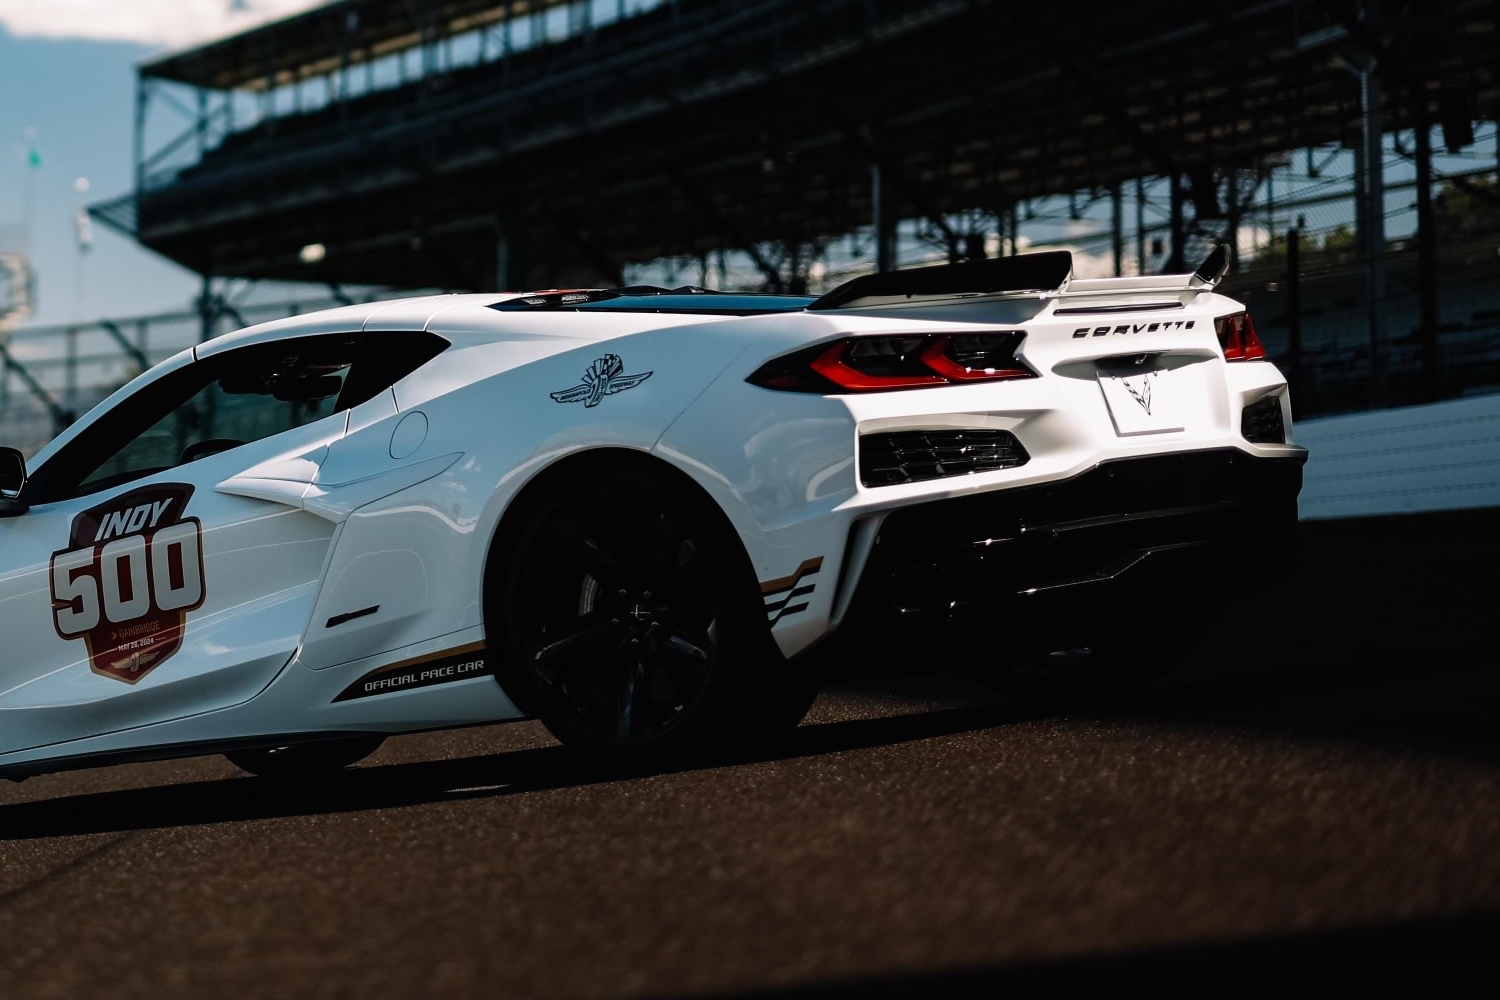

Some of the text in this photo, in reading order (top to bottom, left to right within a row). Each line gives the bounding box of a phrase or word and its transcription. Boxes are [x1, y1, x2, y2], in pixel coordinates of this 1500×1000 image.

[1072, 320, 1196, 339] CORVETTE
[609, 380, 635, 389] SPEEDWAY
[94, 498, 174, 542] INDY
[53, 521, 201, 635] 500
[118, 620, 161, 639] GAINBRIDGE
[118, 642, 130, 652] MAY
[140, 637, 154, 647] 2024
[364, 660, 484, 692] OFFICIAL PACE CAR
